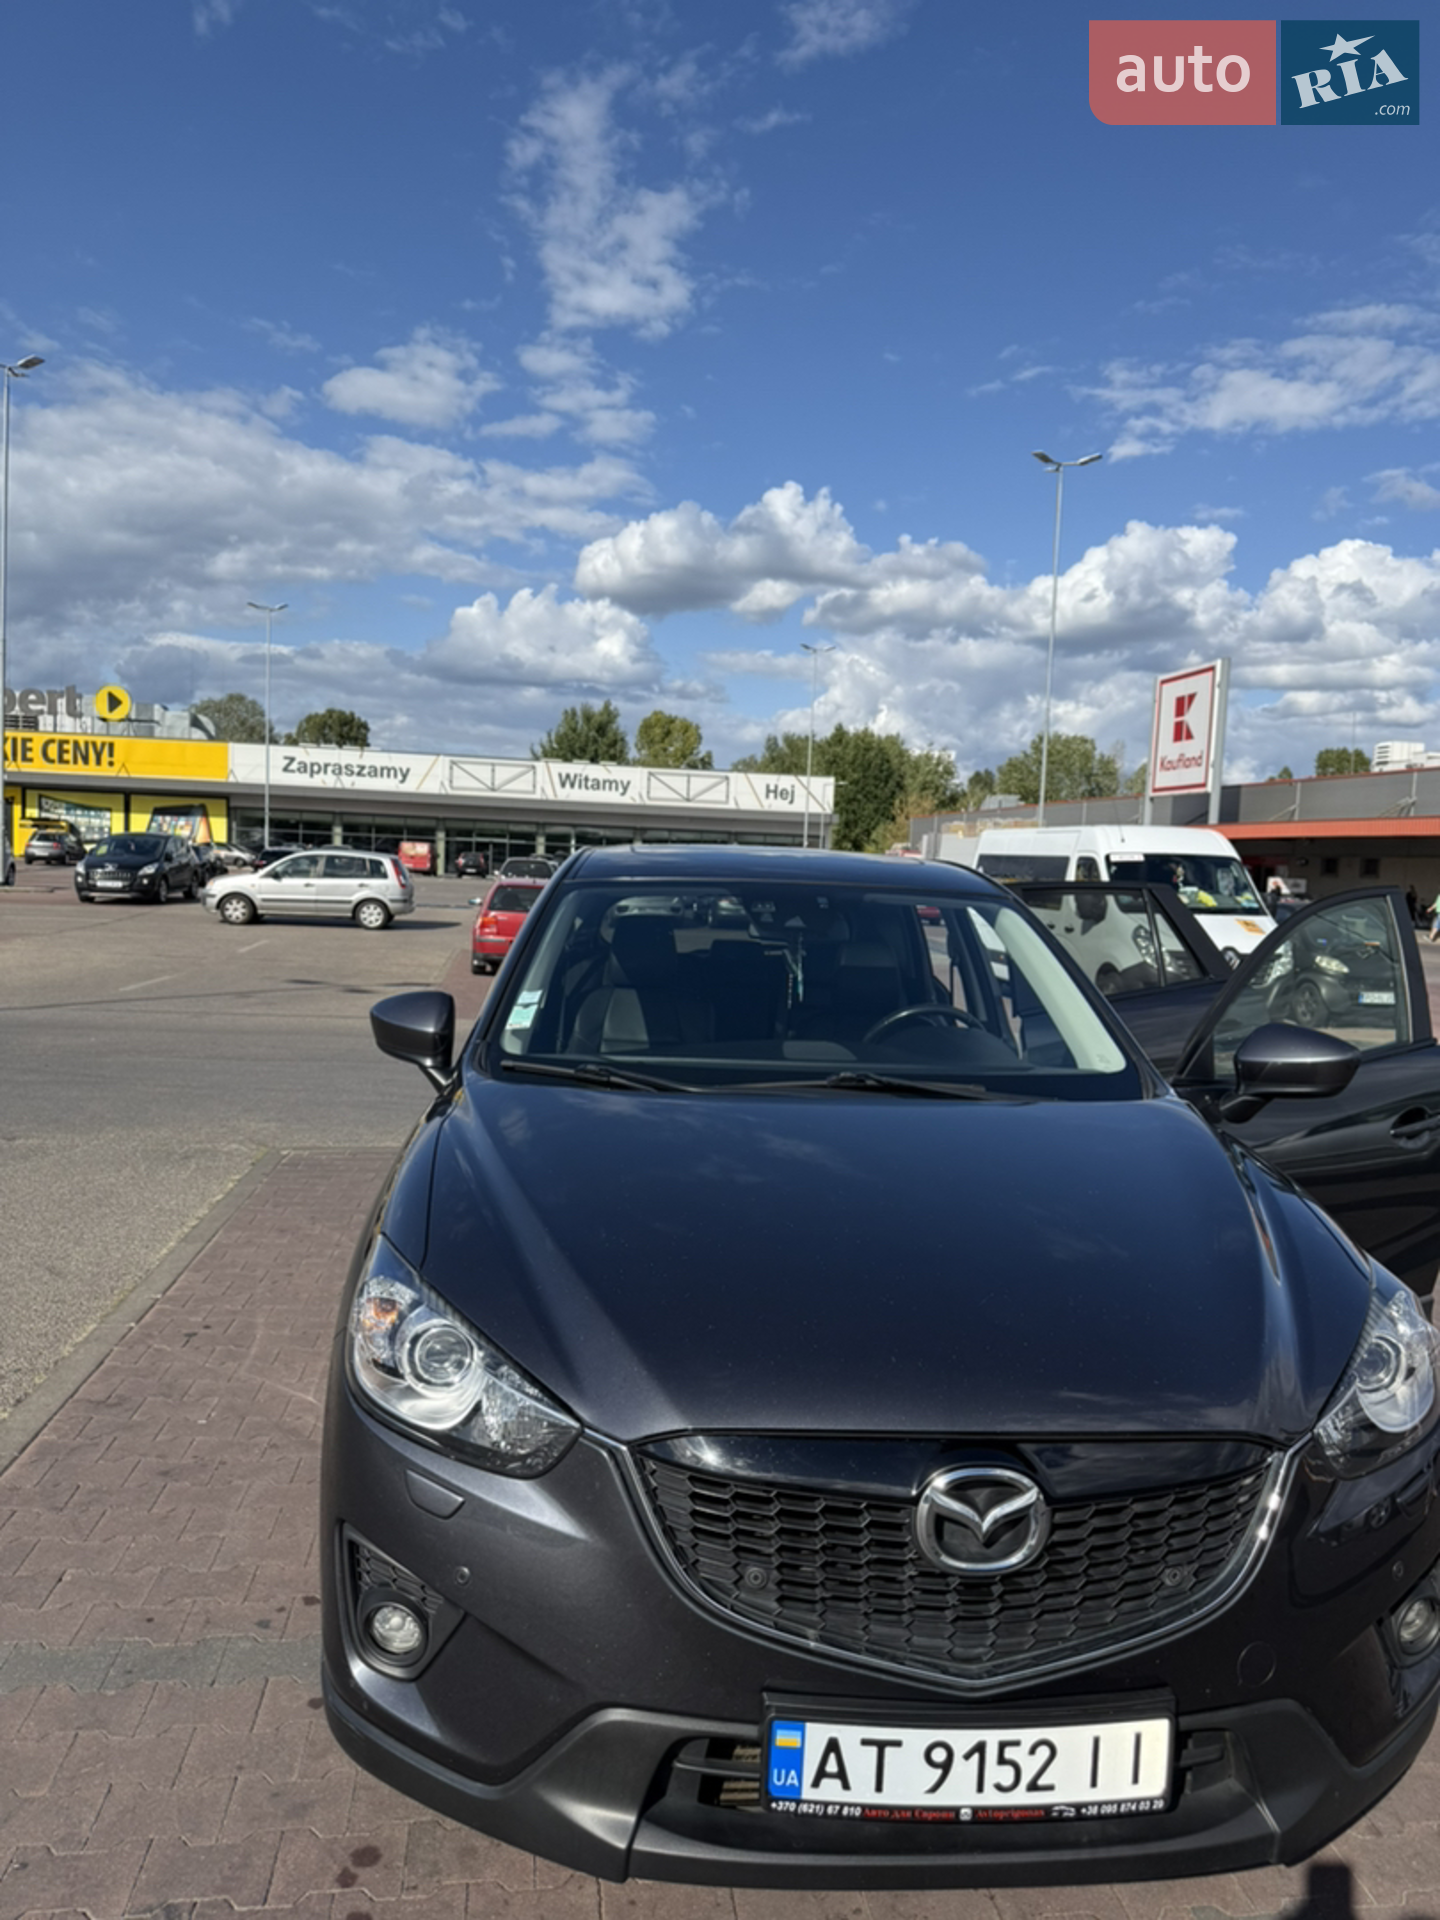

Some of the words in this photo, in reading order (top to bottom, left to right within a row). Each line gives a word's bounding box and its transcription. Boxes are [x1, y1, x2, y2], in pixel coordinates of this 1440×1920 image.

[41, 738, 114, 768] CENY!
[1159, 749, 1203, 772] Kaufland
[282, 756, 411, 784] Zapraszamy
[558, 772, 631, 794] Witamy
[765, 784, 795, 804] Hej
[810, 1737, 903, 1793] AT
[923, 1738, 1059, 1794] 9152
[773, 1768, 799, 1788] UA
[771, 1801, 797, 1812] +370
